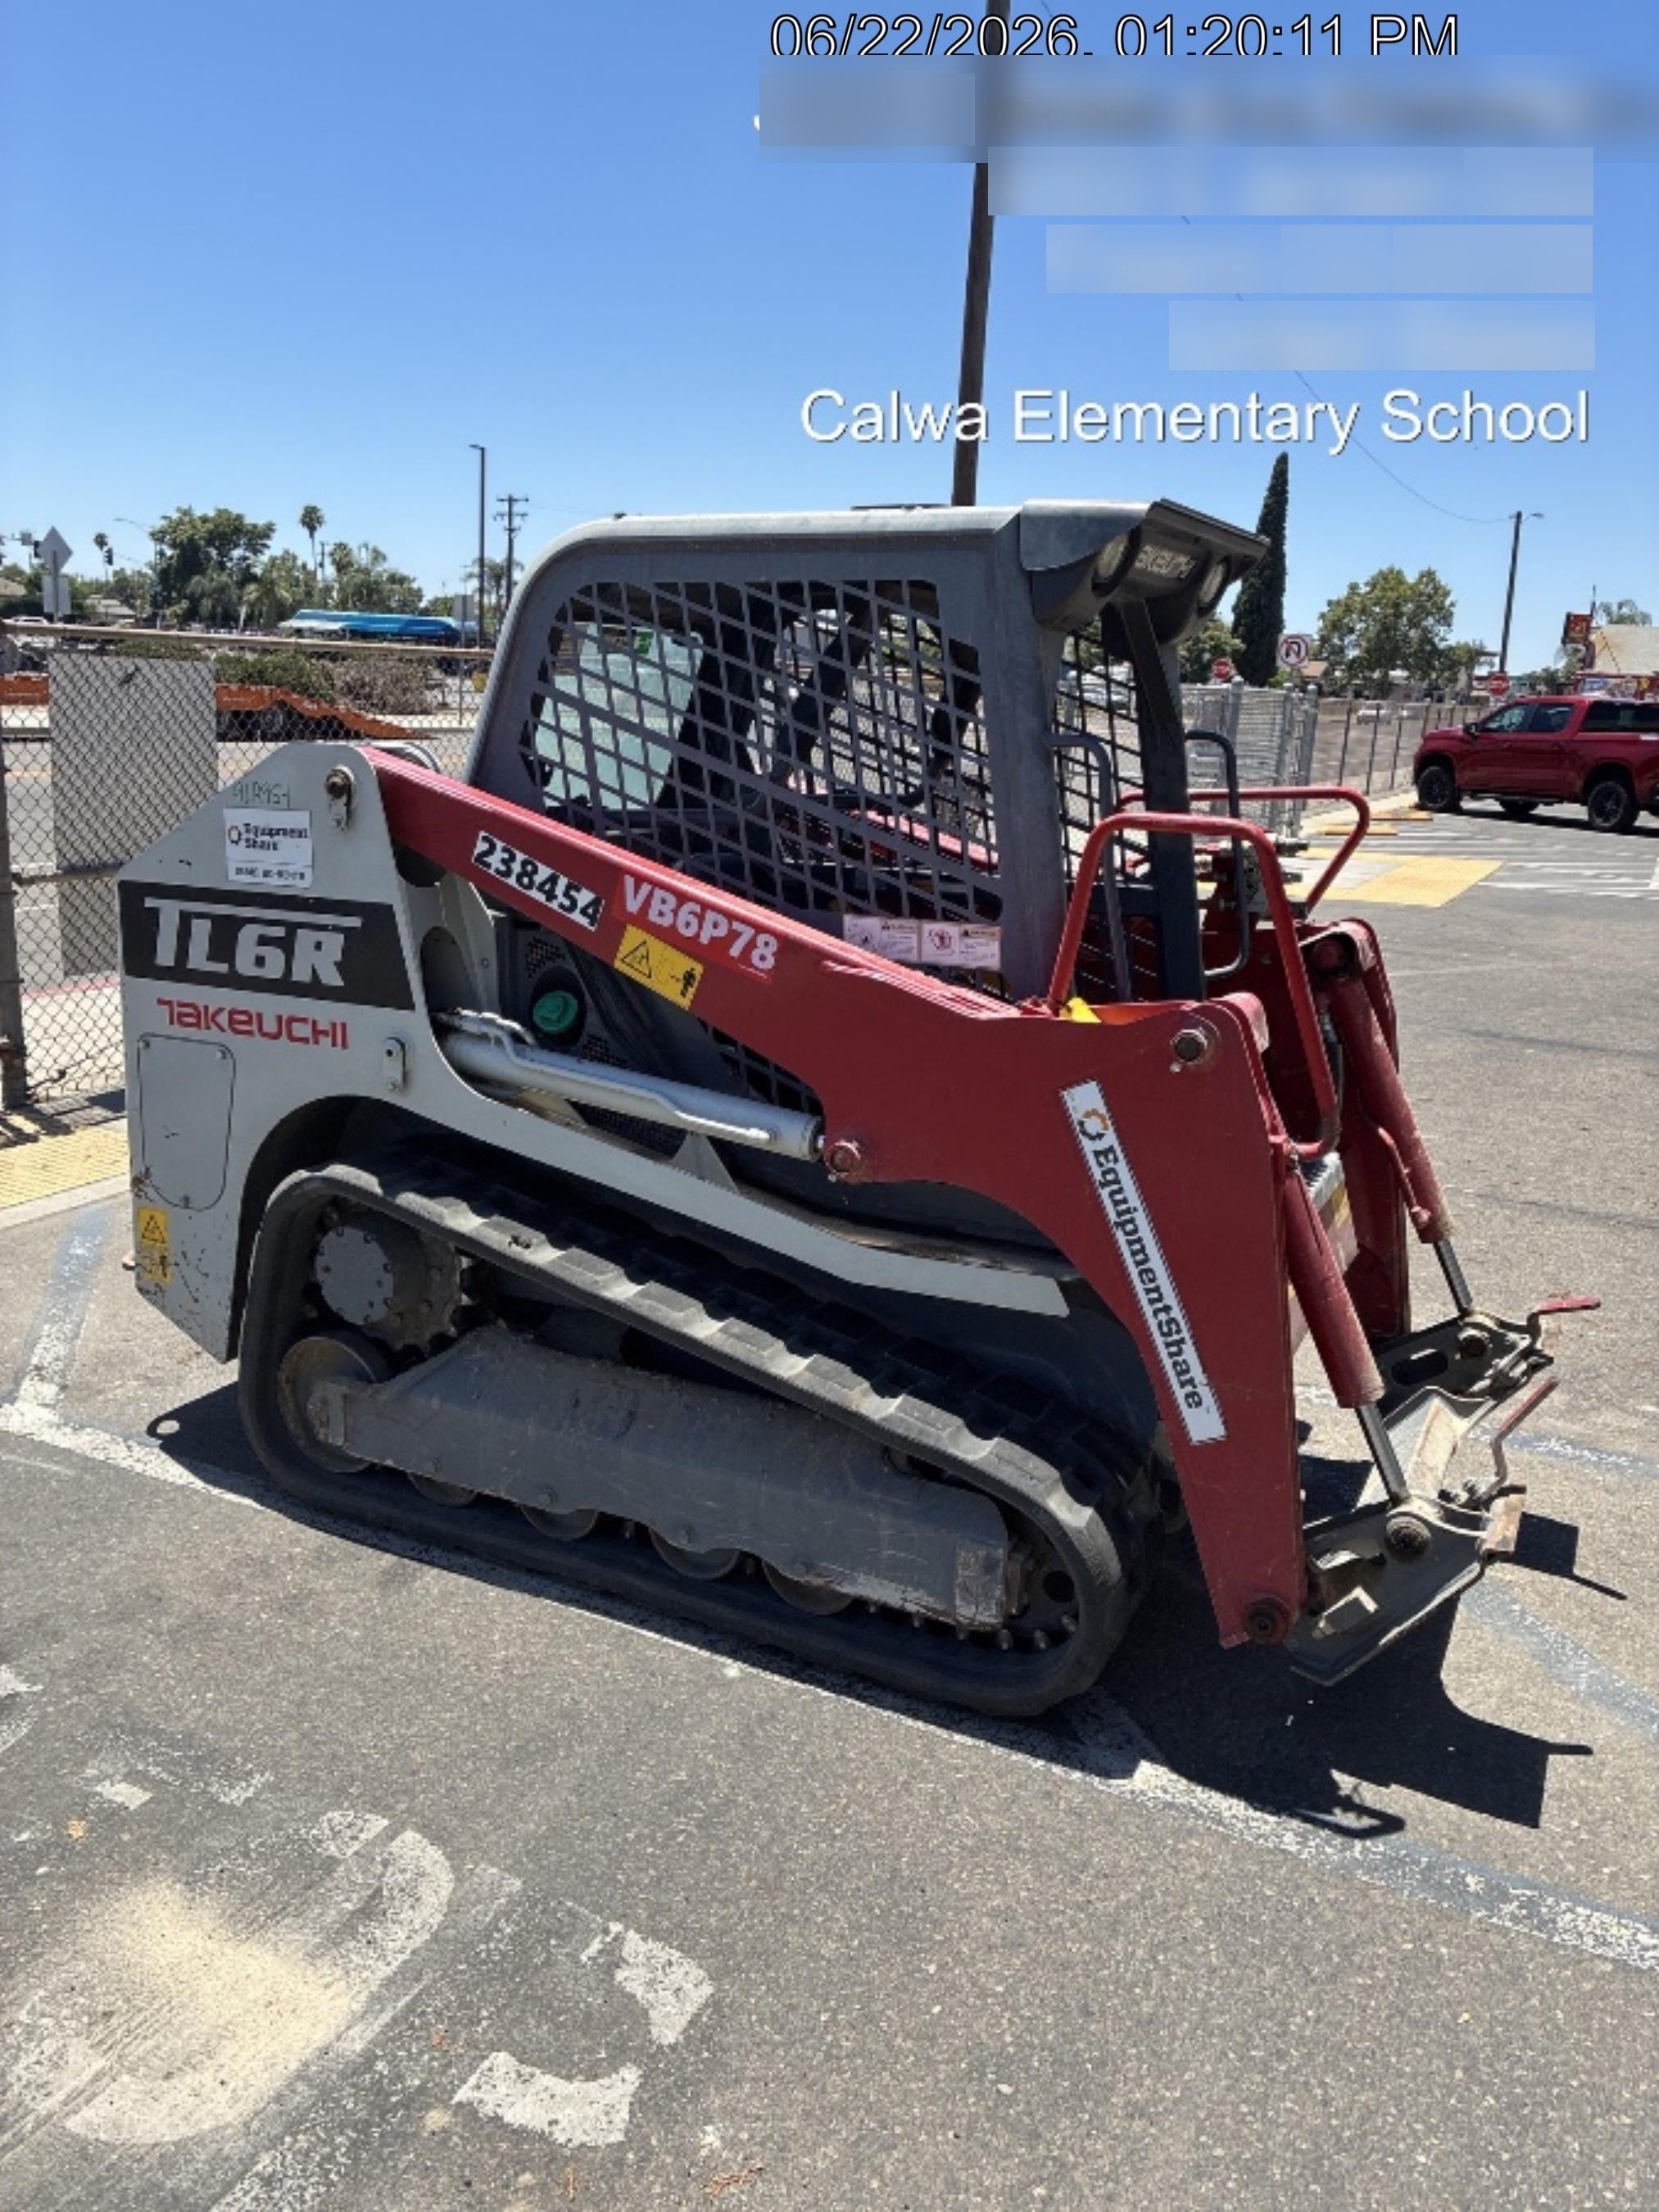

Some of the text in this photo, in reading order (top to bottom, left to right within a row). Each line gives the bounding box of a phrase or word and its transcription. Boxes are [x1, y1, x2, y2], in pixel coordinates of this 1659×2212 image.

[473, 834, 605, 929] 238454
[623, 873, 779, 971] VB6P78
[143, 895, 362, 987] TL6R
[1091, 1144, 1203, 1410] EquipmentShare
